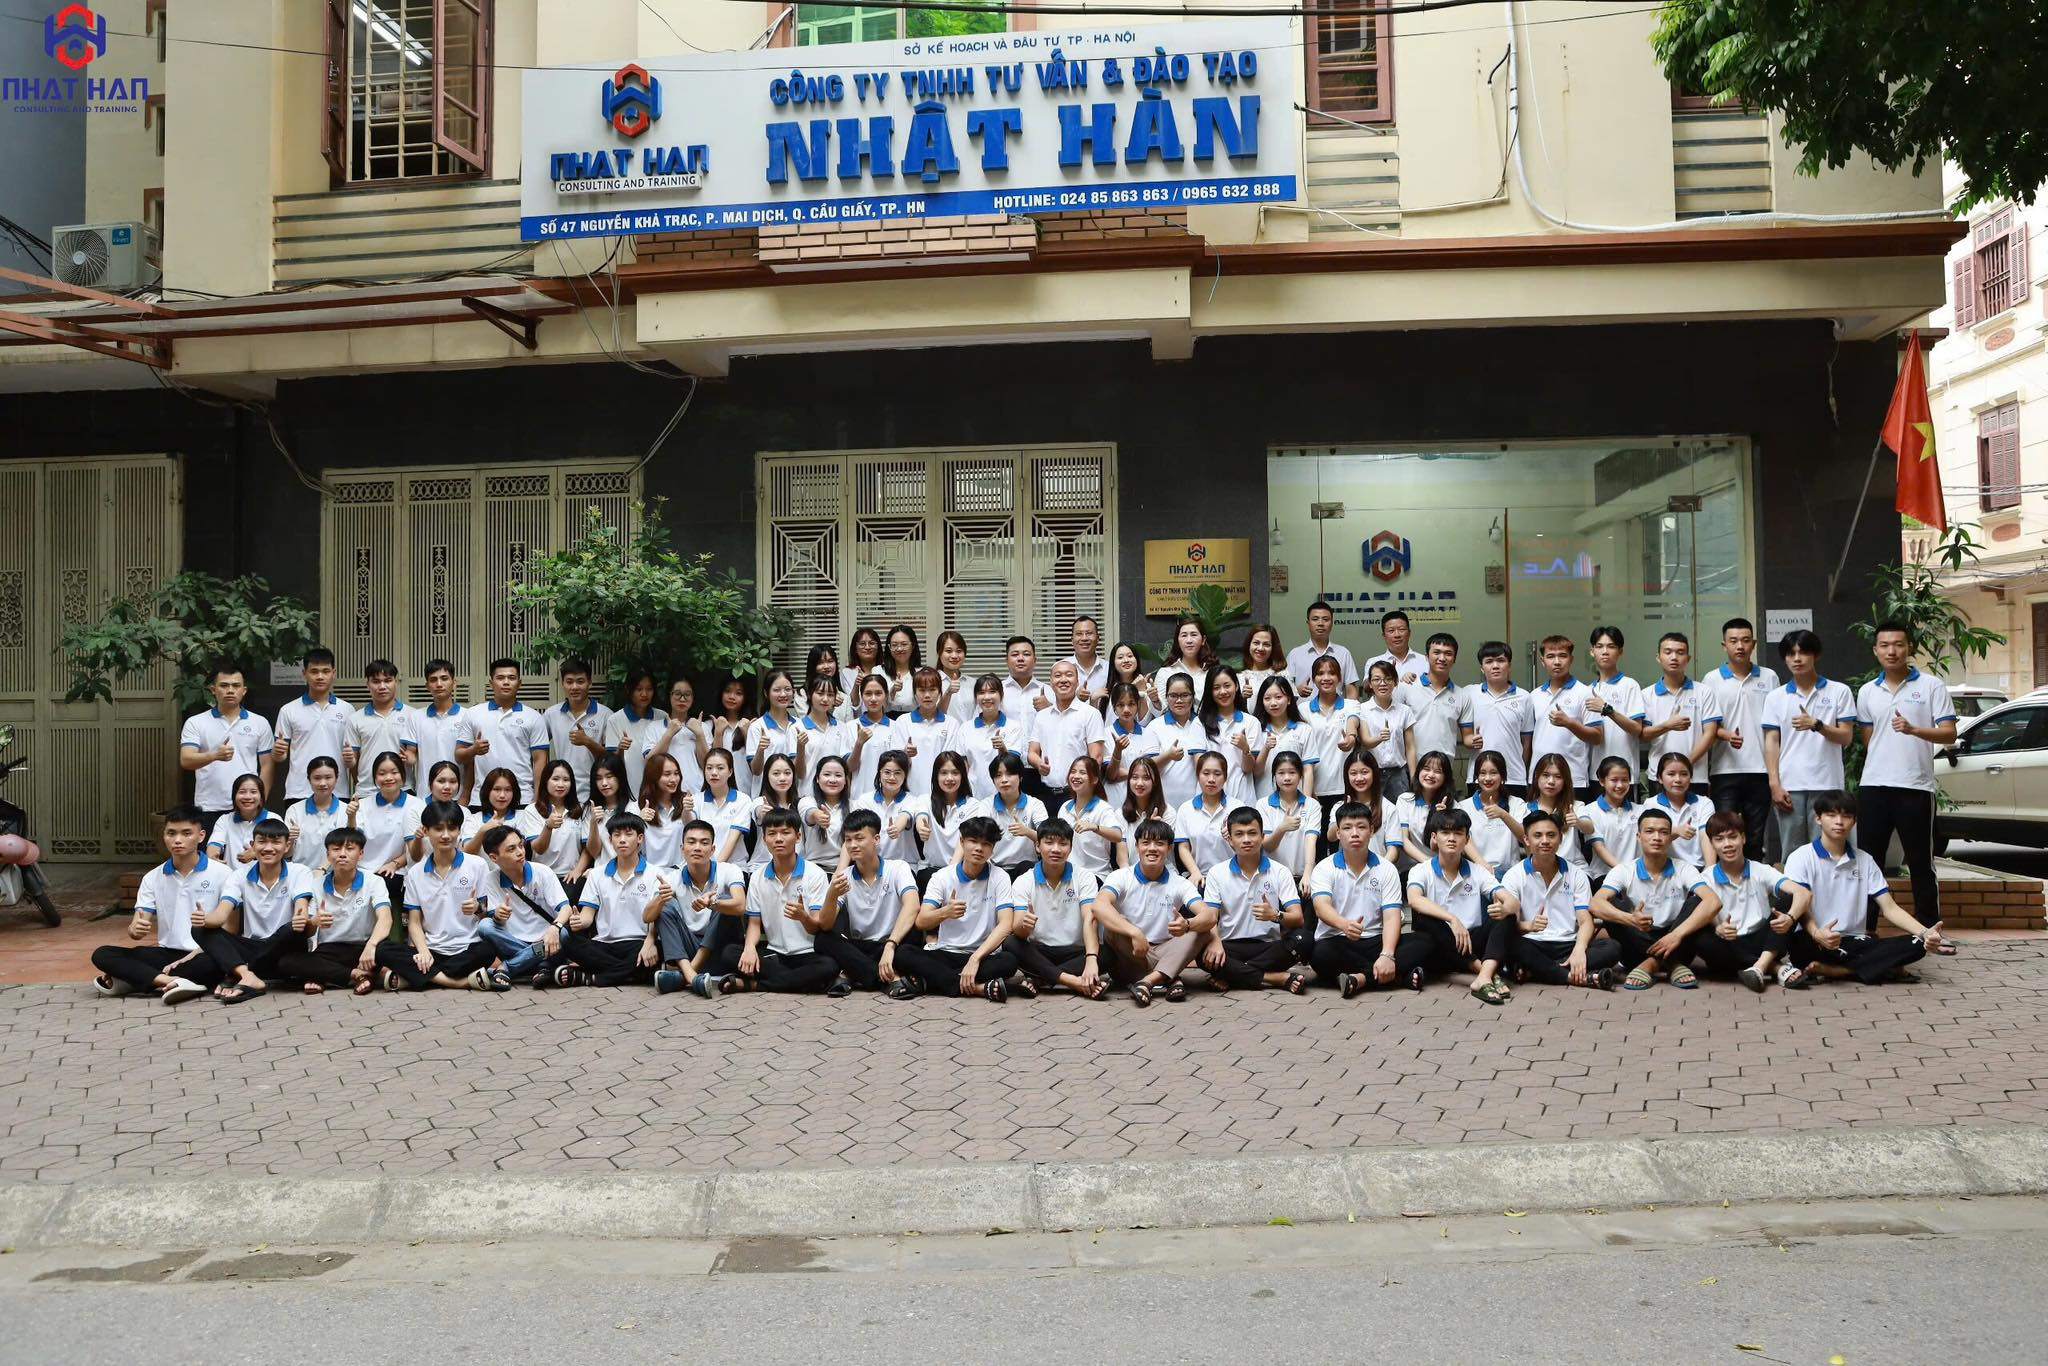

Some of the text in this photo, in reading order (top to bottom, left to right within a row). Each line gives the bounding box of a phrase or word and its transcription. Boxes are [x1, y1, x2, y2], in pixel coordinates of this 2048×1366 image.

[904, 42, 921, 56] SỞ
[927, 41, 944, 54] KẾ
[993, 38, 1008, 50] VÀ
[1044, 35, 1061, 47] TƯ
[1115, 31, 1136, 43] NỘI
[769, 46, 1258, 106] CÔNG TY TNHH TƯ VẤN & ĐÀO TẠO
[765, 87, 1261, 184] NHẬT HÀN
[558, 175, 697, 193] CONSULTING AND TRAINING
[993, 183, 1281, 209] HOTLINE: 024 85 863 863 / 0965 632 888
[540, 218, 557, 235] SỐ
[560, 221, 577, 233] 47
[580, 213, 631, 232] NGUYỄN
[634, 212, 661, 229] KHẢ
[663, 214, 702, 229] TRẠC,
[705, 212, 719, 224] P.
[722, 210, 748, 223] MAI
[752, 208, 788, 224] DỊCH,
[792, 208, 806, 221] Q.
[841, 201, 876, 218] GIẤY,
[880, 202, 901, 216] TP.
[906, 200, 925, 214] HN
